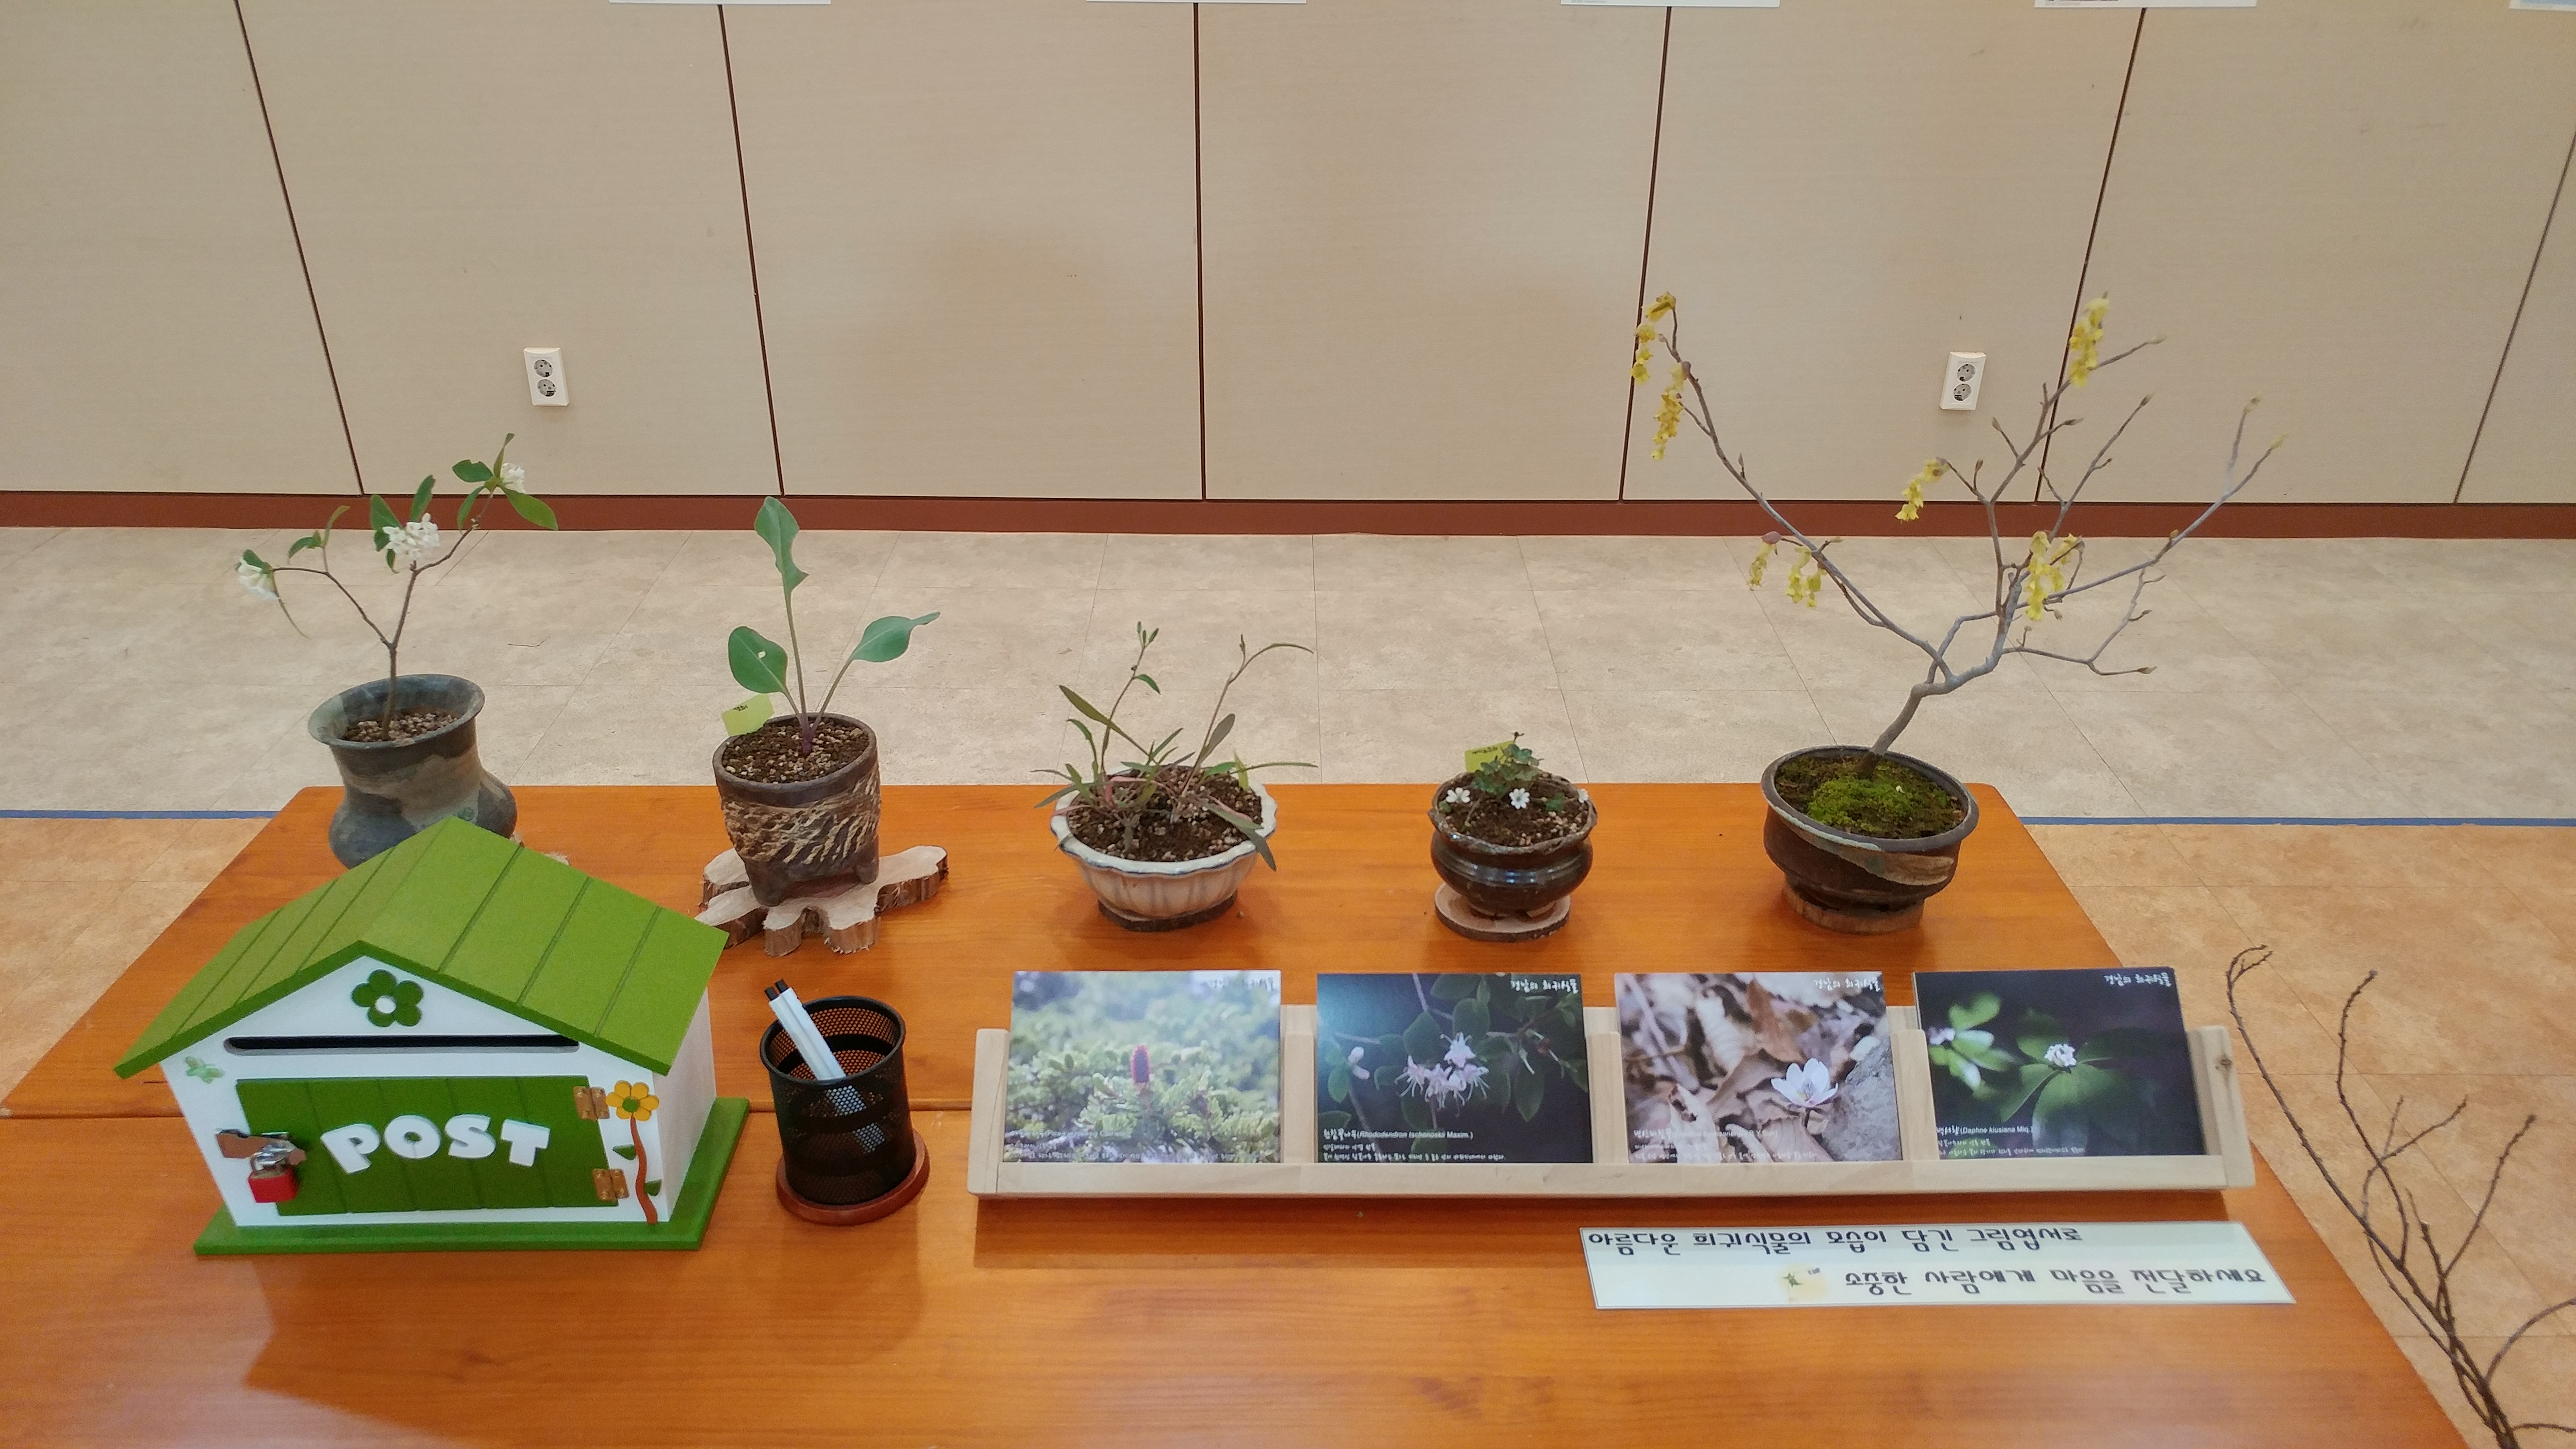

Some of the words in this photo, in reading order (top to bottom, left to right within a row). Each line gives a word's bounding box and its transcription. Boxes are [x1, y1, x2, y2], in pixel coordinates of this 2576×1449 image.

[321, 1113, 551, 1175] POST
[1588, 1232, 1681, 1256] 아름다운
[1692, 1231, 1811, 1255] 희귀식물의
[1826, 1230, 1887, 1253] 모습이
[1901, 1229, 1959, 1252] 담긴
[1970, 1228, 2083, 1251] 그림엽서로
[1845, 1272, 1912, 1296] 소중한
[1925, 1270, 2035, 1294] 사람에게
[2050, 1269, 2125, 1294] 마음을
[2129, 1269, 2267, 1294] 전달하세요
